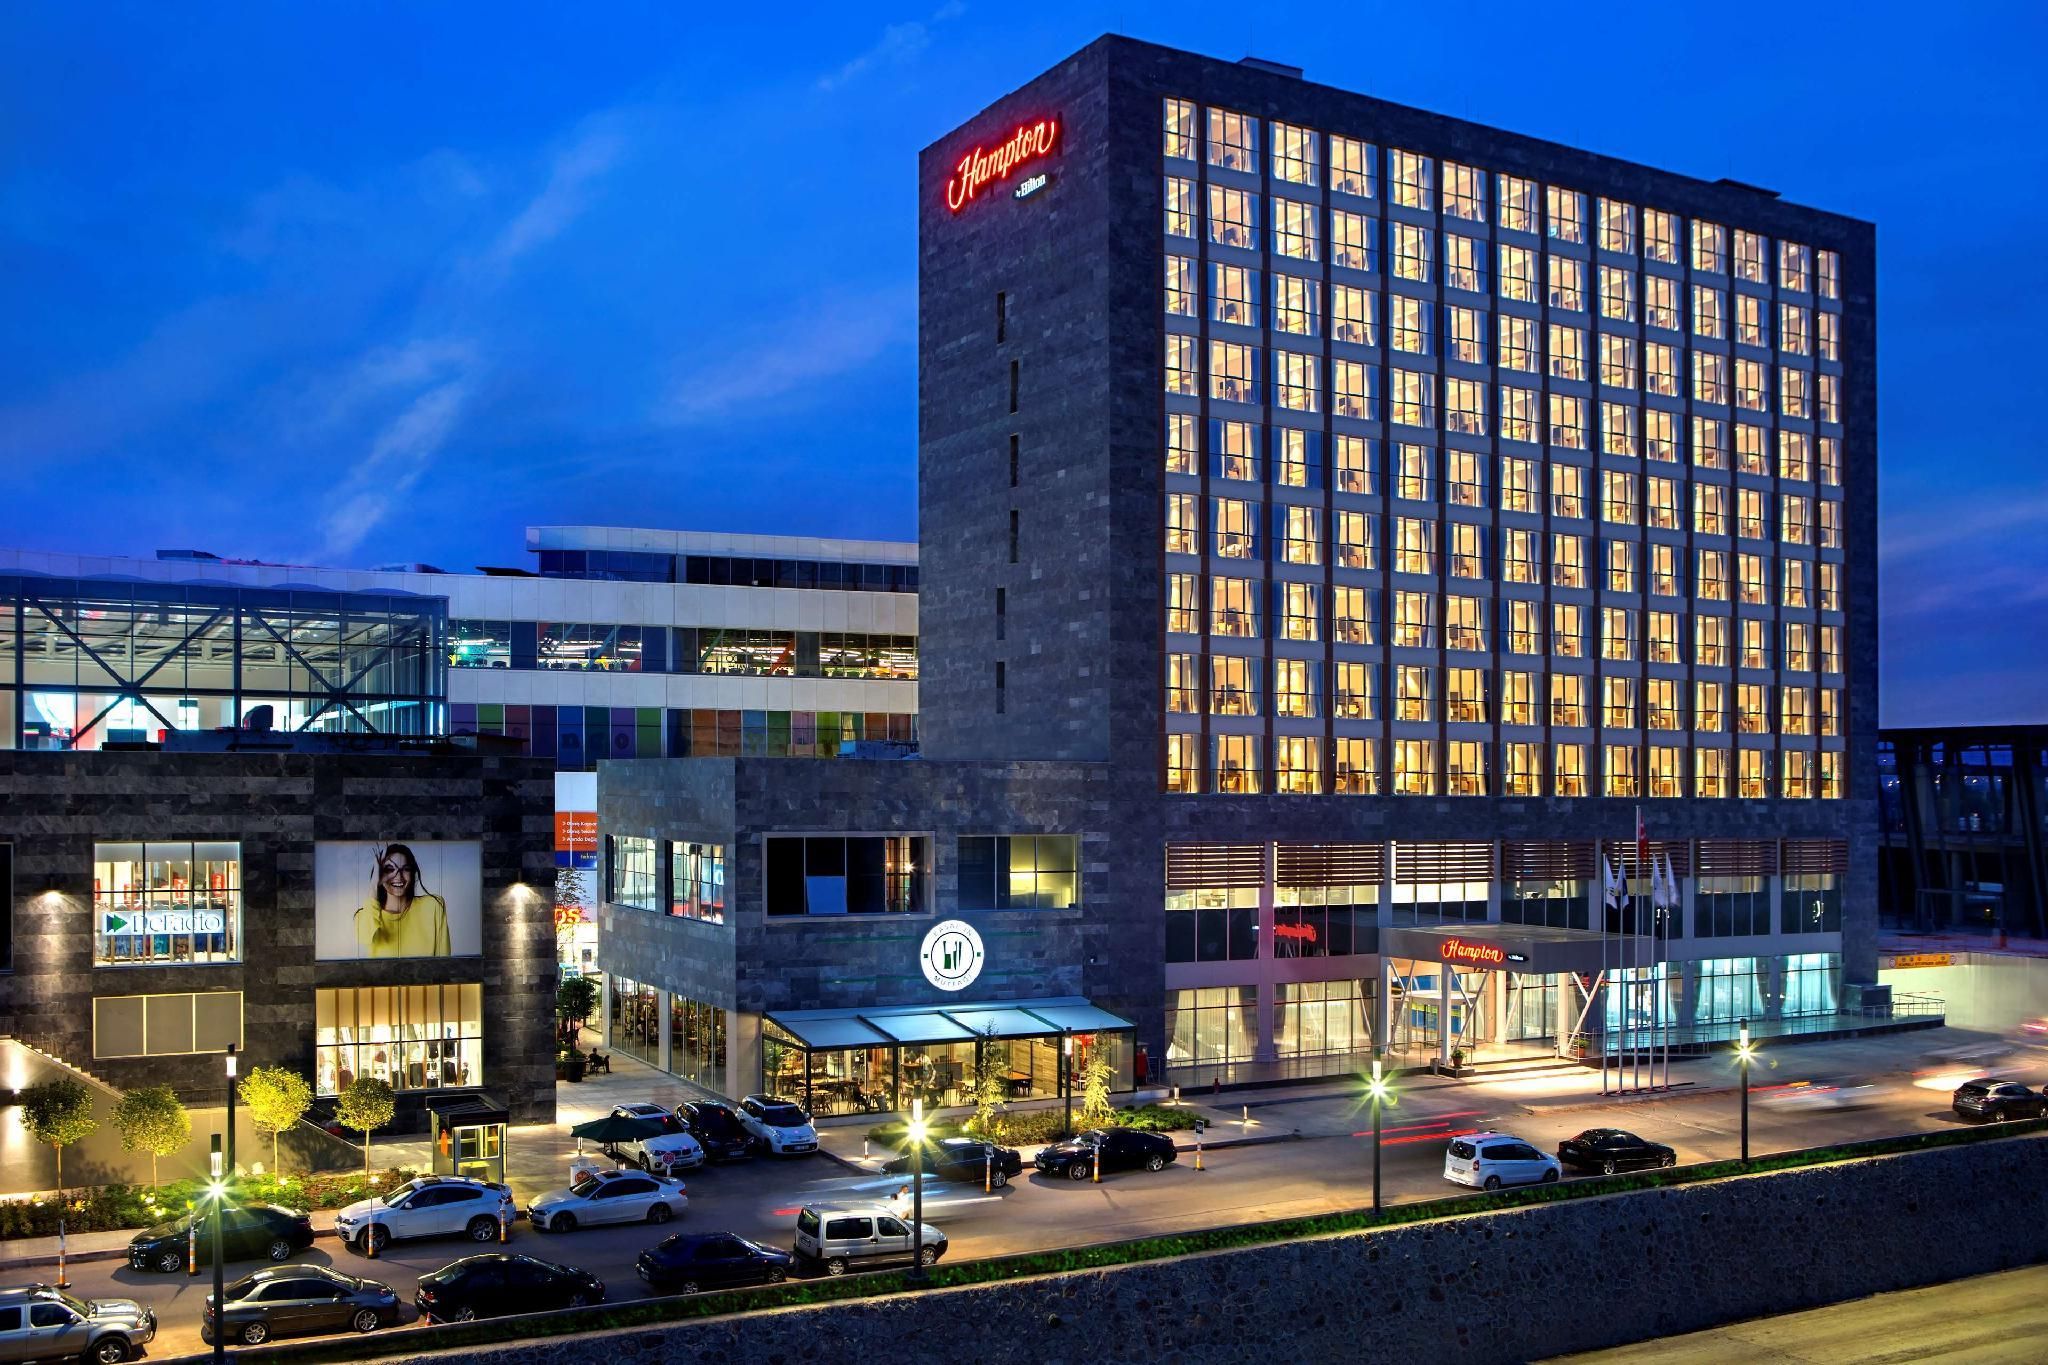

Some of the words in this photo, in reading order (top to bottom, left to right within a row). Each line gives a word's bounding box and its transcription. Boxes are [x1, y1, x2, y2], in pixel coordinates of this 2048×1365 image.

[947, 120, 1055, 210] Hampton
[1021, 174, 1046, 197] Hilton
[133, 912, 220, 932] DeFacto
[1442, 939, 1504, 963] Hampton
